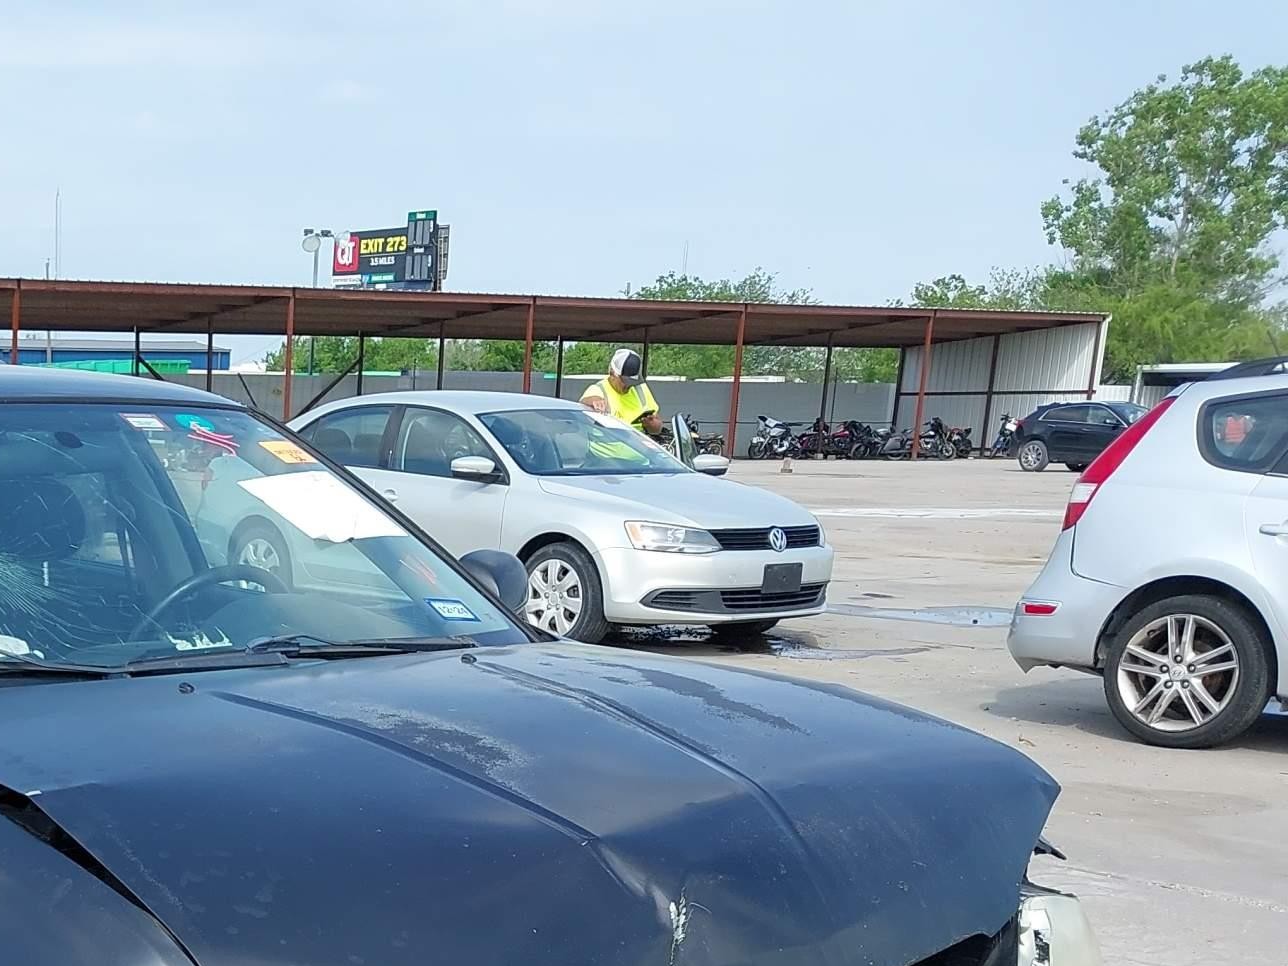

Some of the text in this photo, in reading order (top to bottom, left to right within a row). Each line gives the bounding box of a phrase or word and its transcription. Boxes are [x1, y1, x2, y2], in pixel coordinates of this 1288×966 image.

[336, 239, 355, 266] QT
[360, 235, 408, 254] EXIT 273
